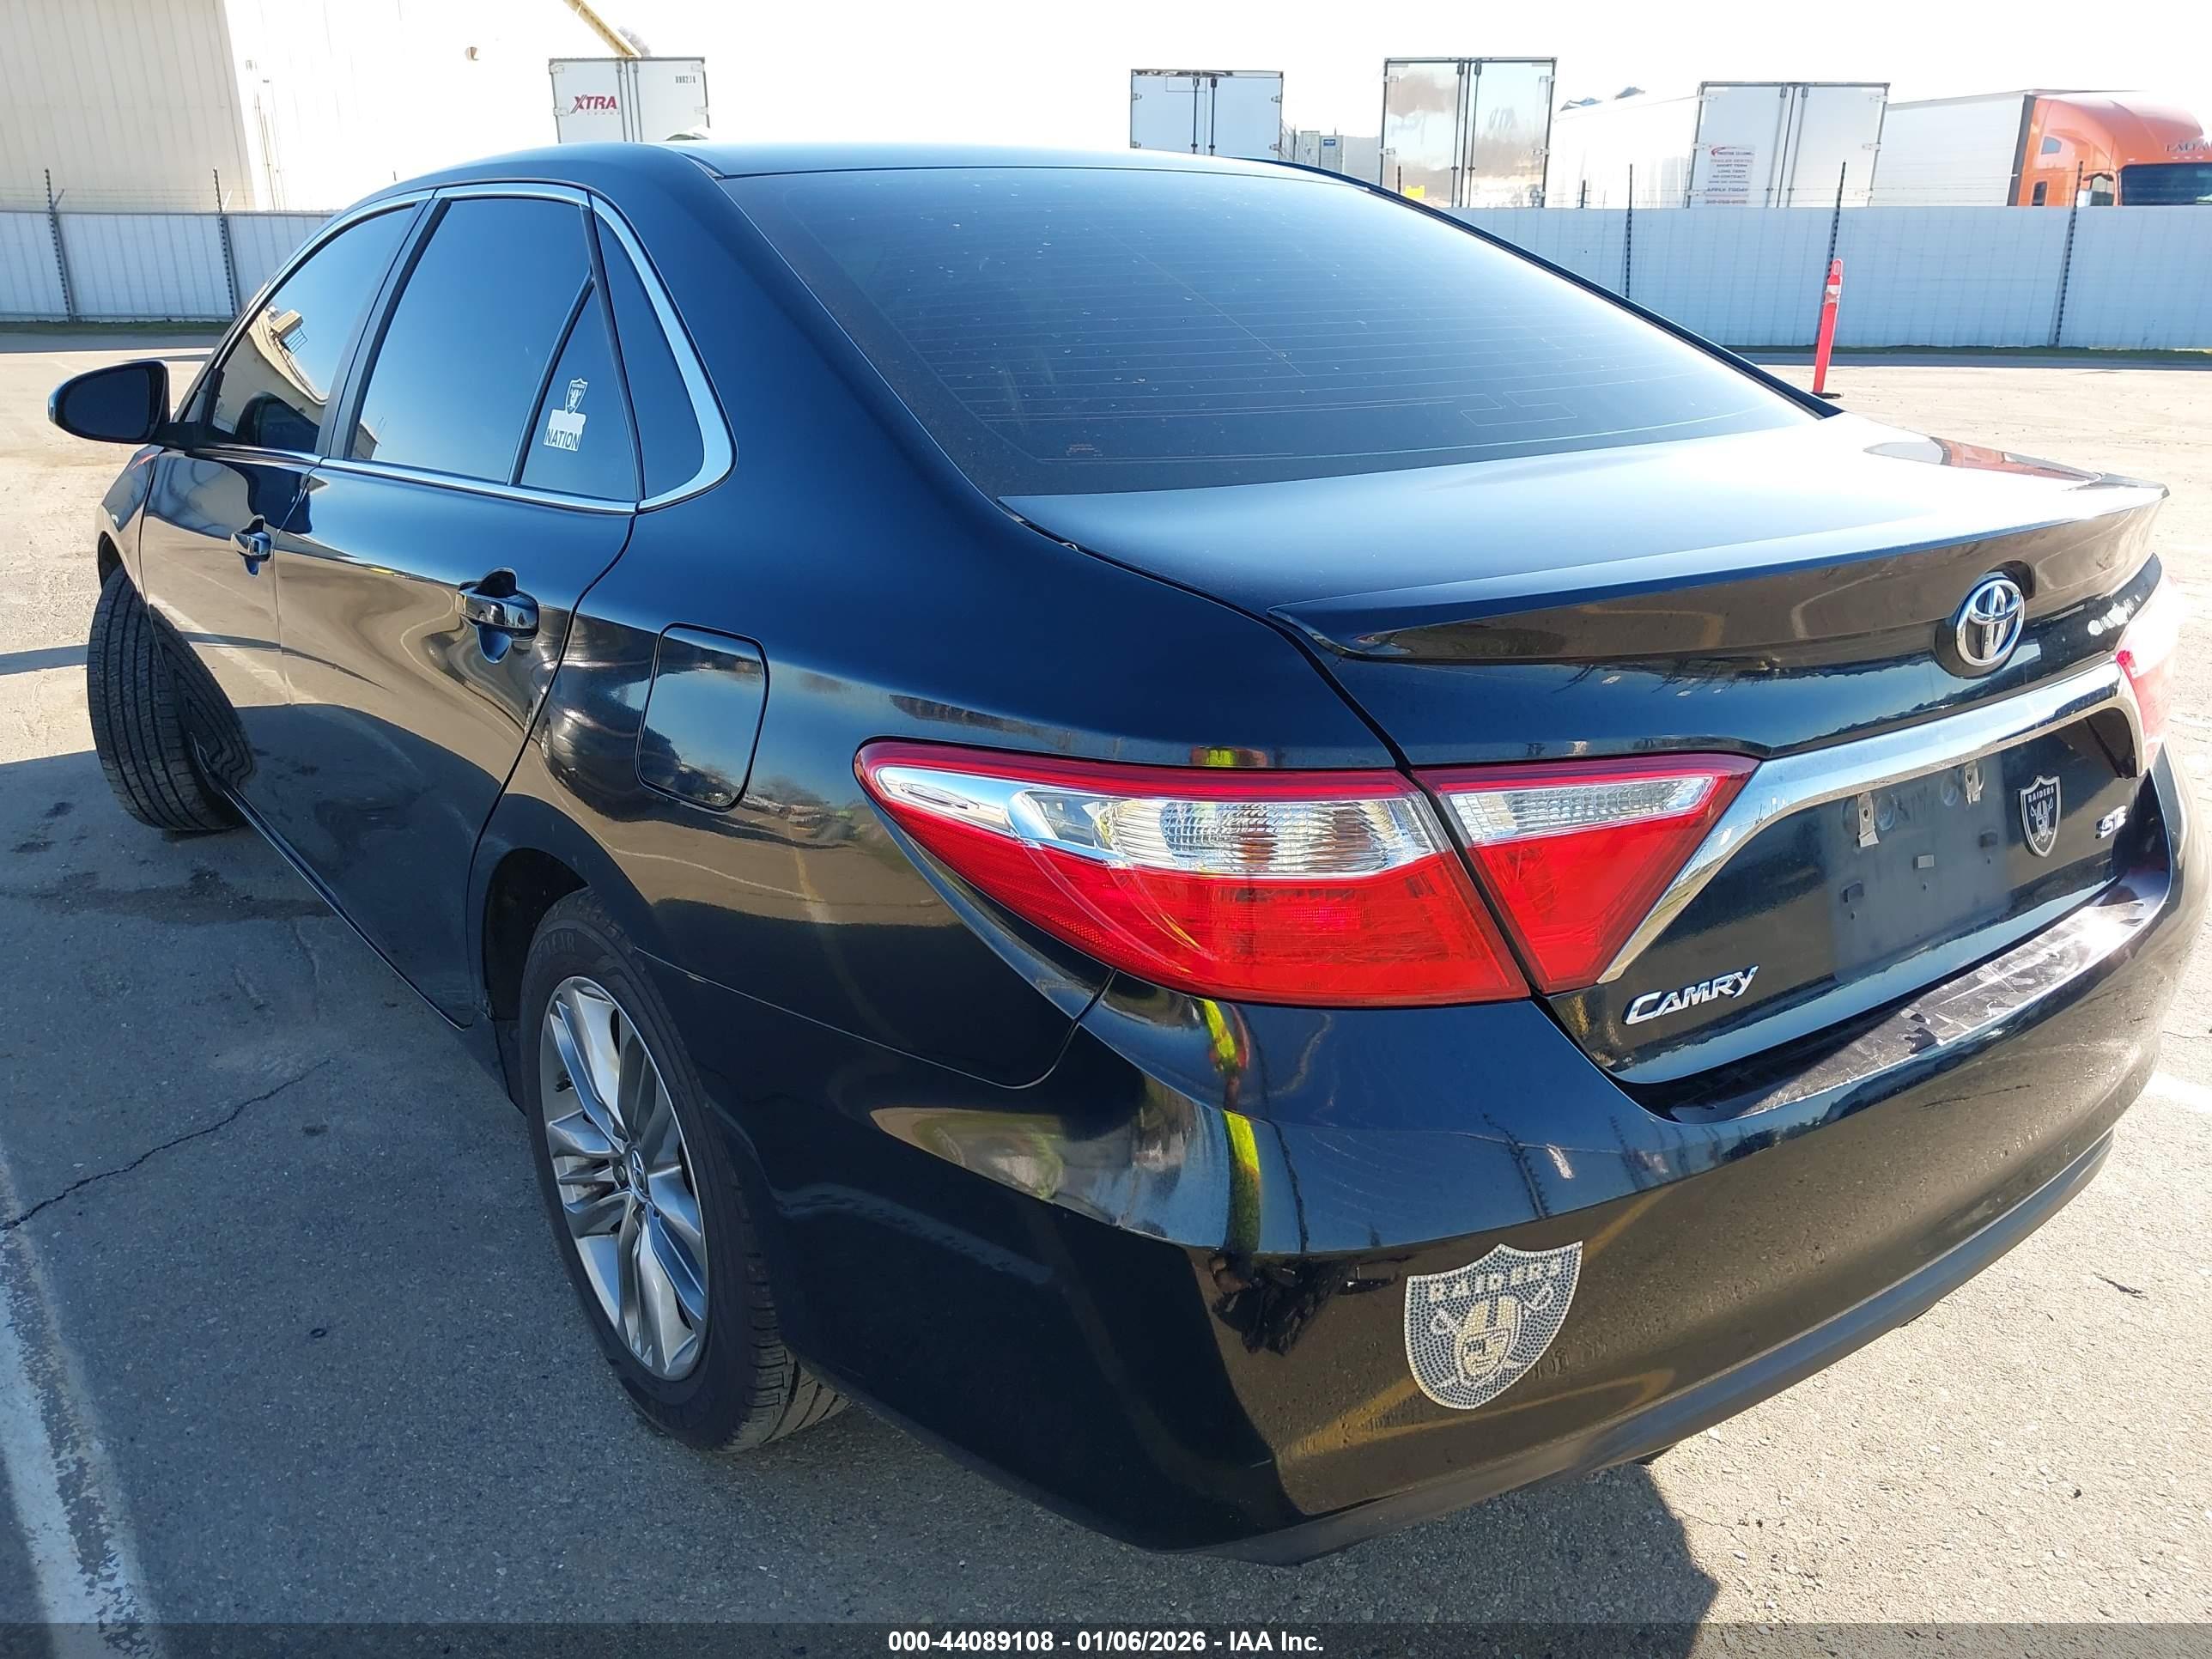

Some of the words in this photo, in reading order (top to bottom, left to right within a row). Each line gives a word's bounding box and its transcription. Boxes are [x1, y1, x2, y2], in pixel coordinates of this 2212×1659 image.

[570, 94, 617, 114] XTRA
[544, 428, 581, 450] NATION
[2027, 786, 2055, 803] RAIDERS
[1624, 965, 1759, 1025] CAMRY
[1429, 1257, 1562, 1303] RAIDERS
